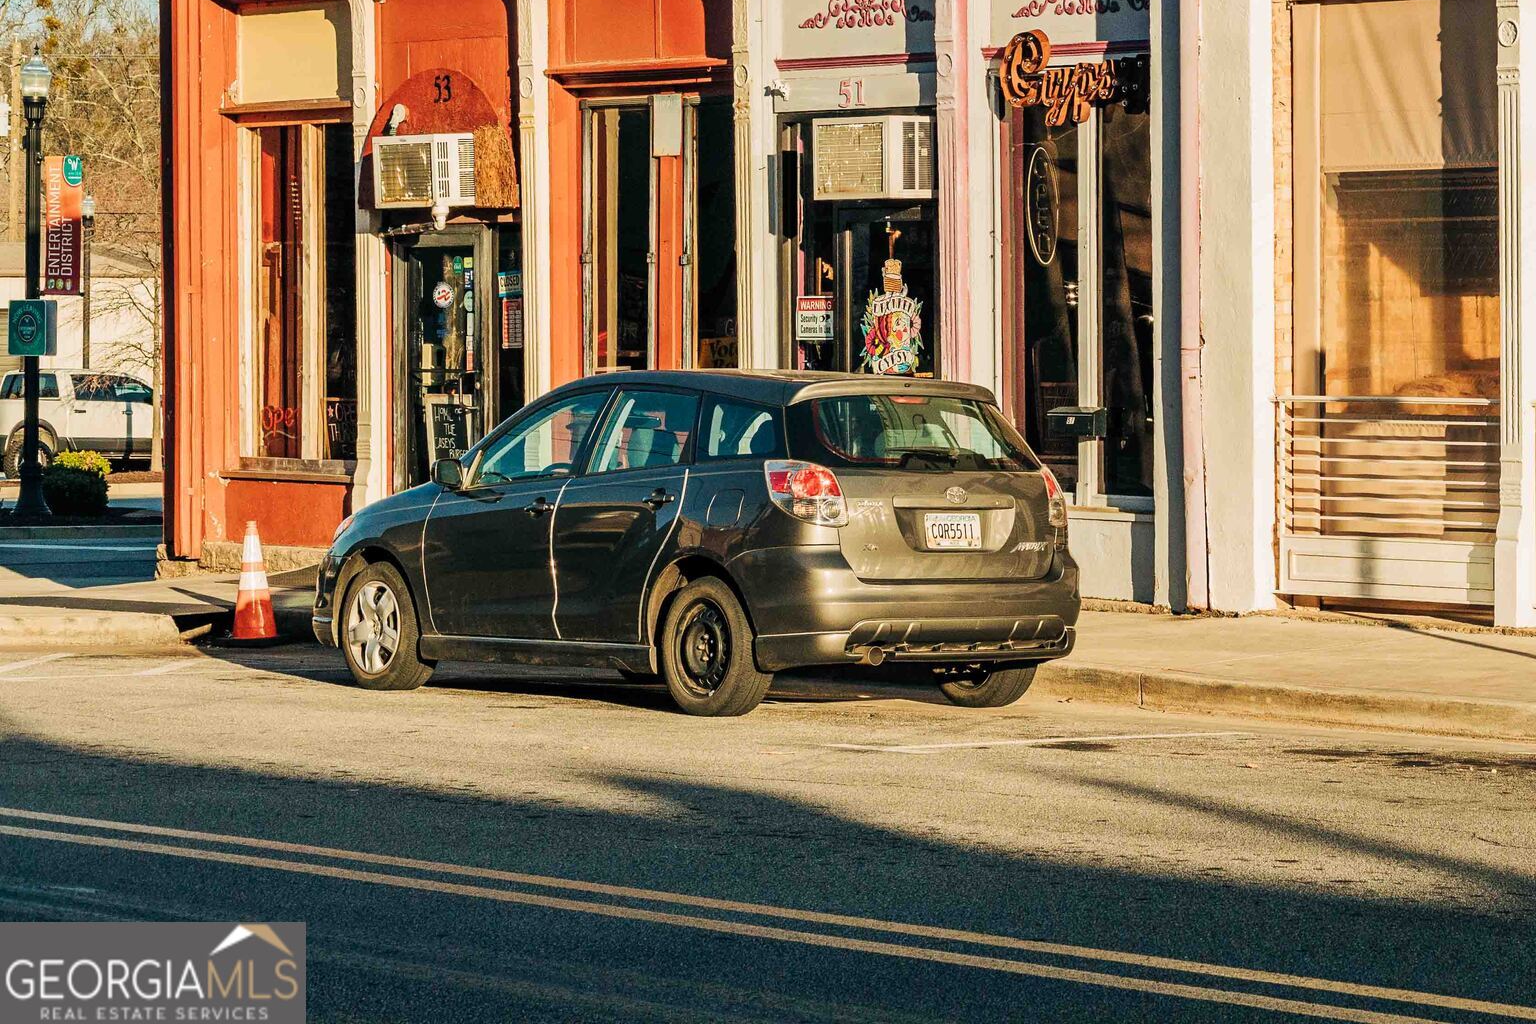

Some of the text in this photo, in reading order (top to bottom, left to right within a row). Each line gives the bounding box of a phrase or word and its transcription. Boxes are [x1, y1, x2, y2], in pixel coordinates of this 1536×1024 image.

[433, 75, 452, 103] 53
[838, 79, 865, 108] 51
[48, 167, 61, 276] ENTERTAINMENT
[61, 216, 73, 276] DISTRICT
[499, 275, 520, 288] CLOSED
[800, 299, 832, 310] WARNING
[800, 314, 818, 324] Security
[800, 325, 818, 334] Cameras
[931, 523, 974, 539] CQR5511
